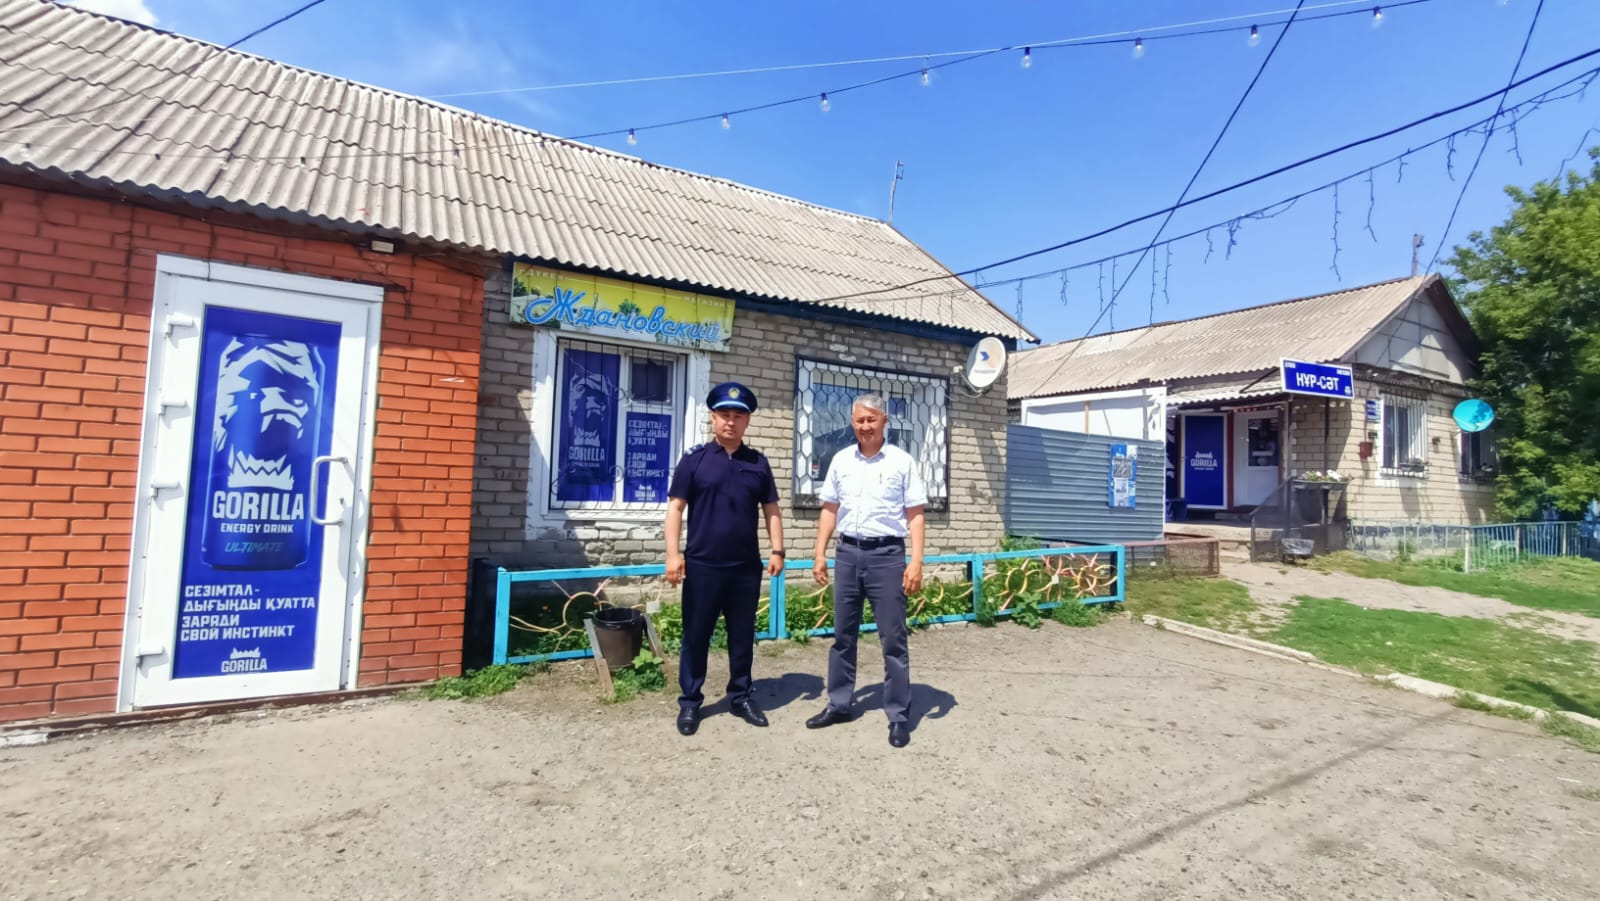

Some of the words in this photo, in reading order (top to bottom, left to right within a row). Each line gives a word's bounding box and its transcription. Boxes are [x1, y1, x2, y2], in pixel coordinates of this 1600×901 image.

[524, 286, 720, 342] Ждановский
[1190, 458, 1218, 467] GORILLA
[635, 490, 656, 498] GORLLA
[212, 490, 305, 521] GORILLA
[220, 522, 262, 534] ENERGY
[263, 523, 294, 534] DRINK
[224, 541, 284, 553] ULTIMATE
[183, 598, 262, 612] ДЫҒЫҢДЫ
[265, 597, 316, 611] ҚУАТТА
[181, 614, 240, 628] ЗАРЯДИ
[180, 627, 219, 642] СВОЙ
[222, 625, 296, 640] ИНСТИНКТ
[220, 658, 268, 673] GORILLA
